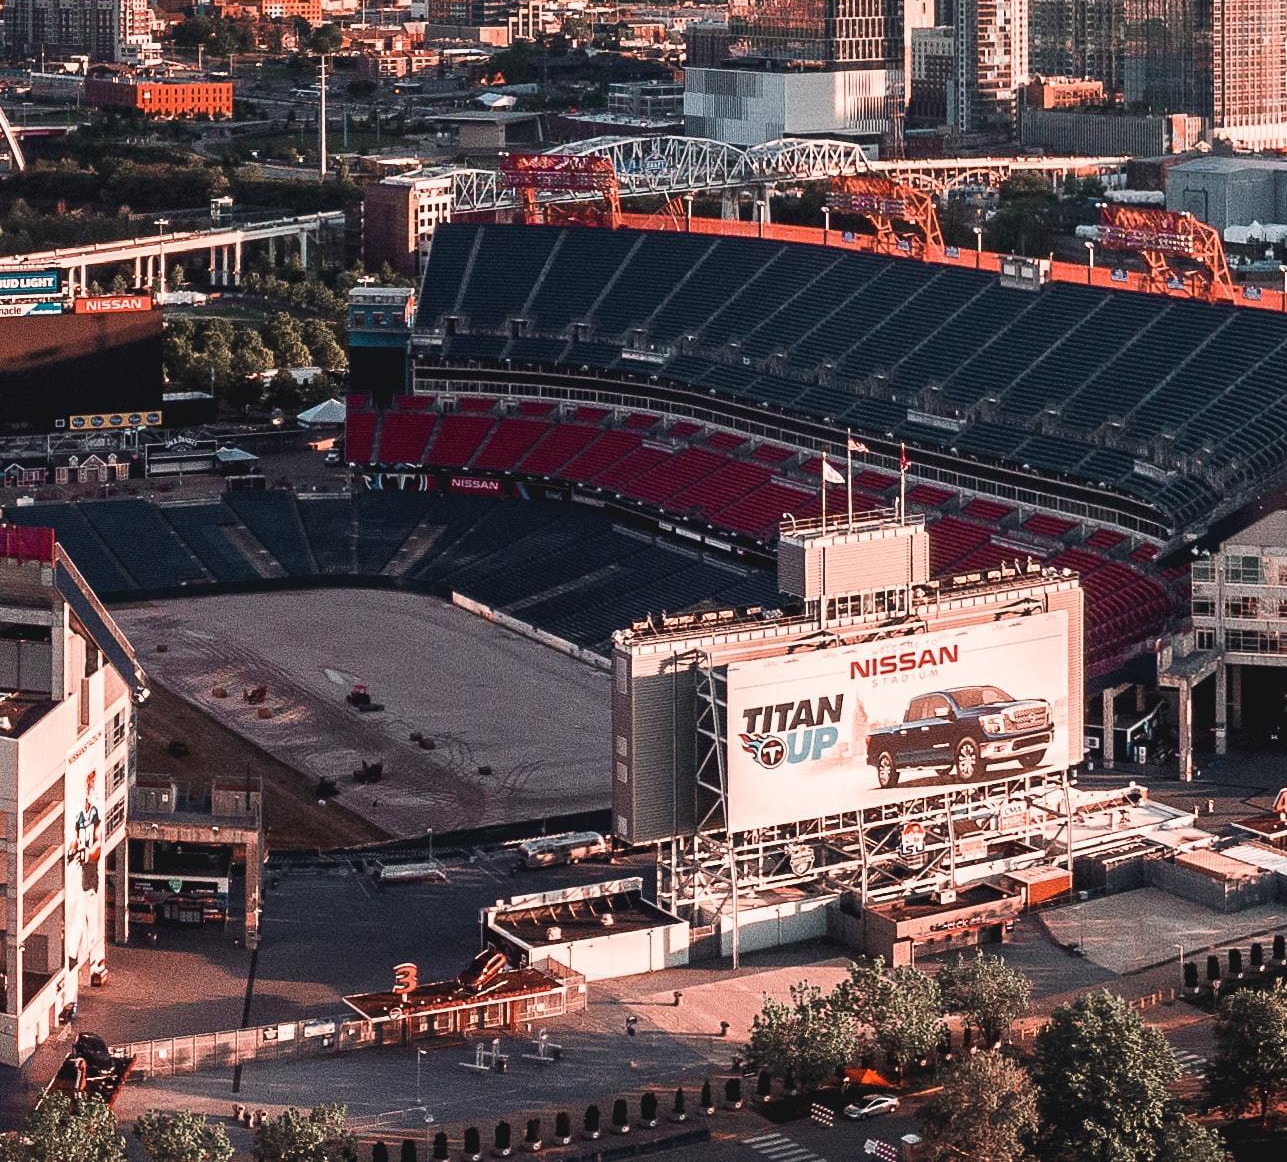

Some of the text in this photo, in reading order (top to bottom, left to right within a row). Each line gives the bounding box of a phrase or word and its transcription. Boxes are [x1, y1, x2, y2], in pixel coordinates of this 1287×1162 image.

[20, 277, 54, 288] LIGHT
[85, 299, 142, 311] NISSAN
[451, 478, 499, 490] NISSAN
[850, 645, 958, 679] NISSAN
[743, 693, 844, 734] TITAN
[787, 726, 839, 764] UP
[392, 962, 418, 994] 3
